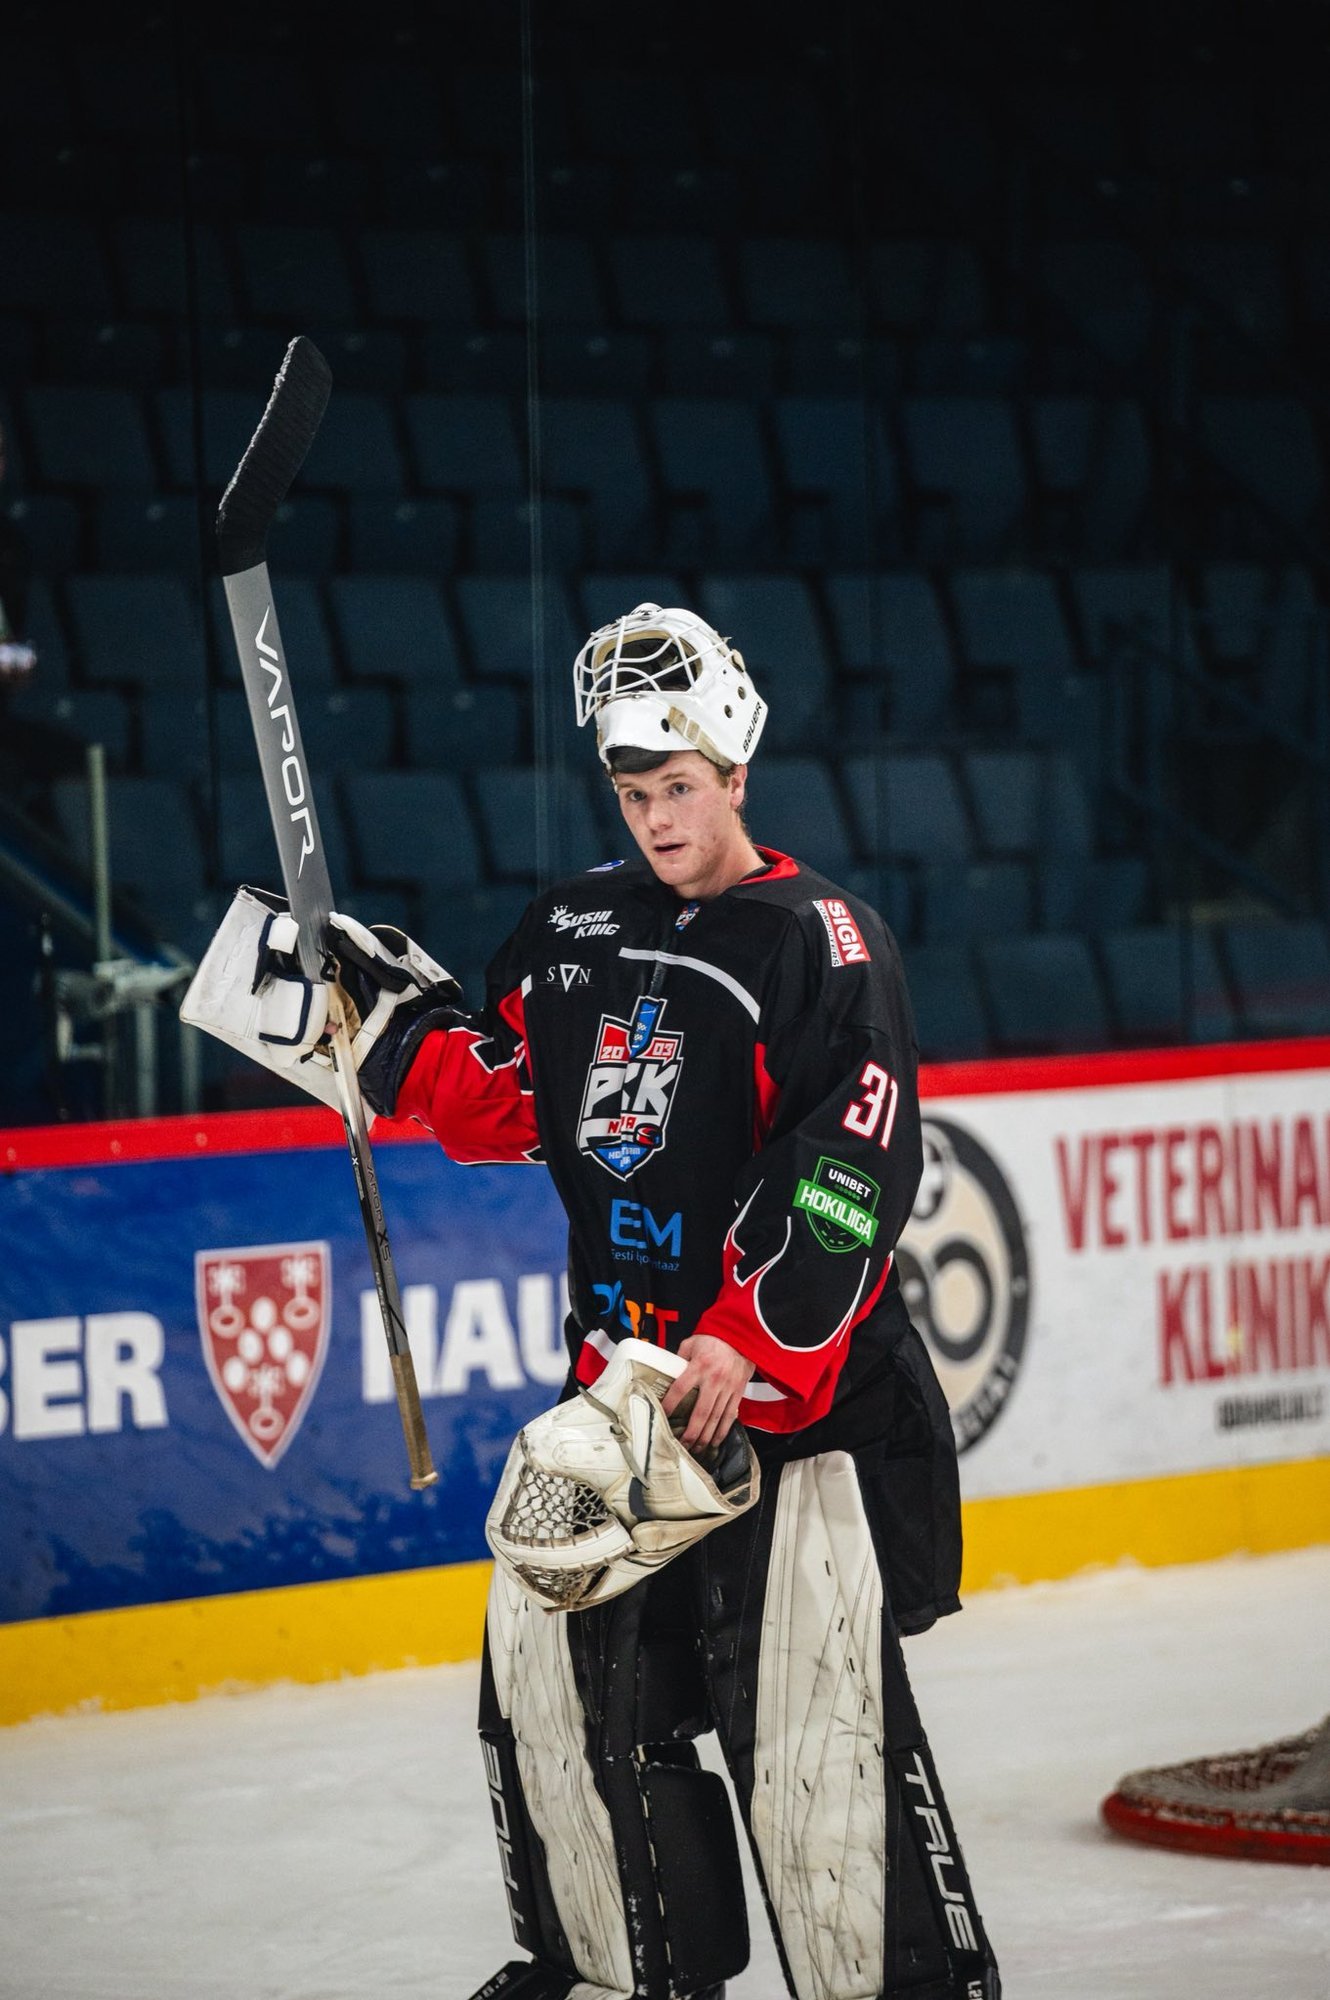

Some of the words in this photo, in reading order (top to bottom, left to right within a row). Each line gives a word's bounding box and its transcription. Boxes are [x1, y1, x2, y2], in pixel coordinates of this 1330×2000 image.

[254, 604, 316, 882] VAPOR
[555, 910, 614, 933] SUSHI
[574, 923, 621, 939] KING
[828, 901, 865, 961] SIGN
[600, 1046, 623, 1060] 20
[652, 1043, 673, 1056] 03
[842, 1061, 899, 1150] 31
[828, 1168, 872, 1198] UNIBET
[1053, 1112, 1330, 1253] VETERINA
[610, 1199, 682, 1257] EM
[800, 1185, 874, 1240] HOKILIIGA
[0, 1310, 169, 1440] ER
[905, 1752, 979, 1951] TRUE
